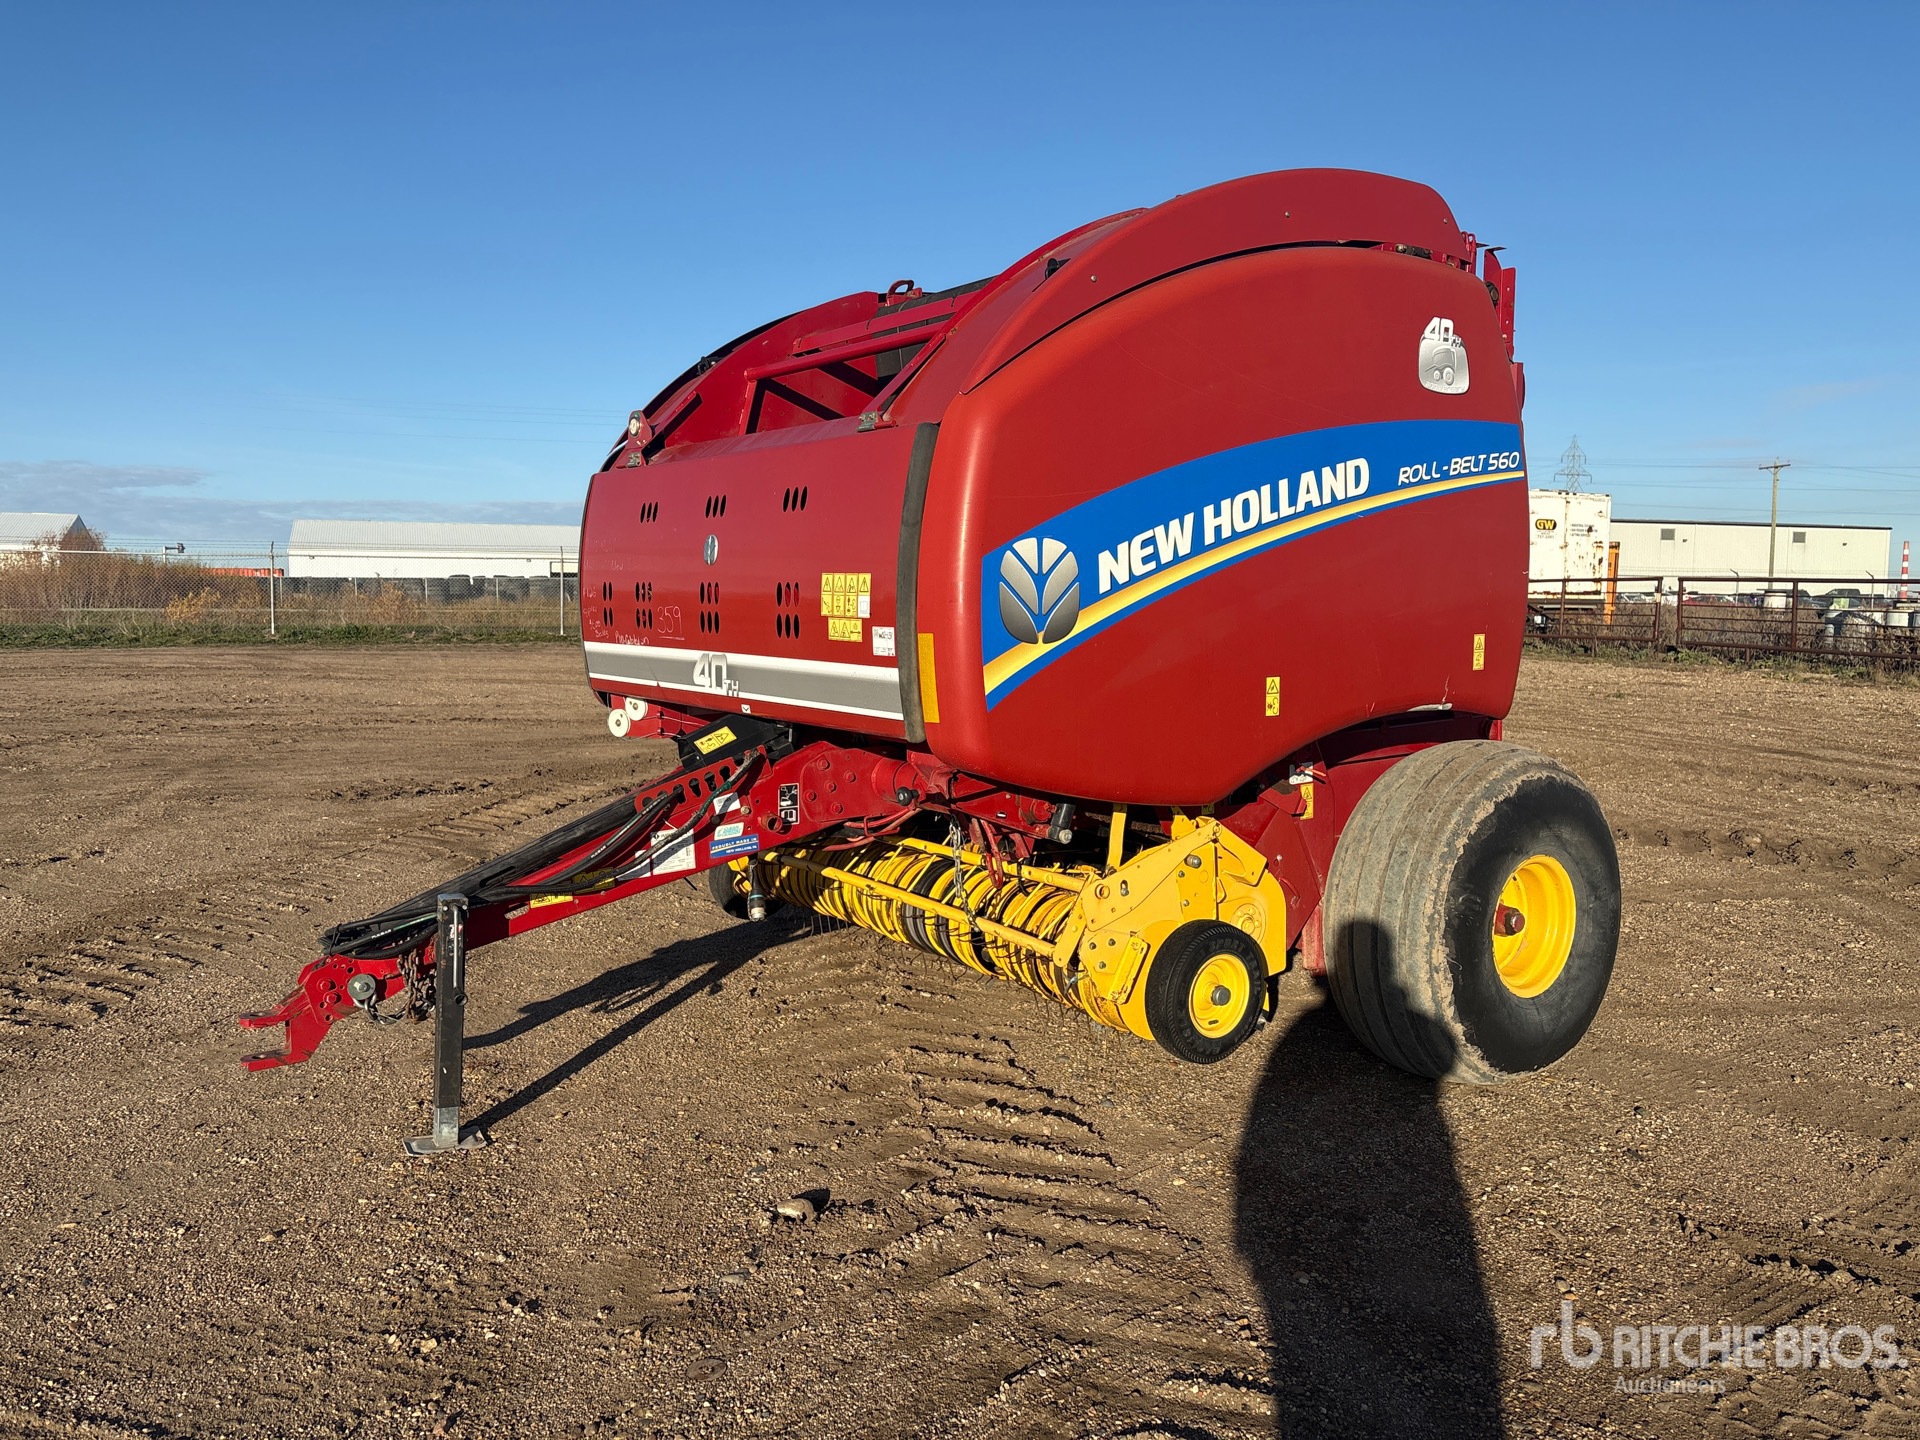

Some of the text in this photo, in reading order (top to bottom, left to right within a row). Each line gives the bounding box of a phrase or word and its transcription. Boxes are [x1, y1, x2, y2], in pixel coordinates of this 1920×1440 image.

[1397, 450, 1521, 485] ROLL-BELT 560
[1096, 457, 1370, 595] NEW HOLLAND
[1536, 519, 1555, 530] GW
[656, 605, 682, 634] 359
